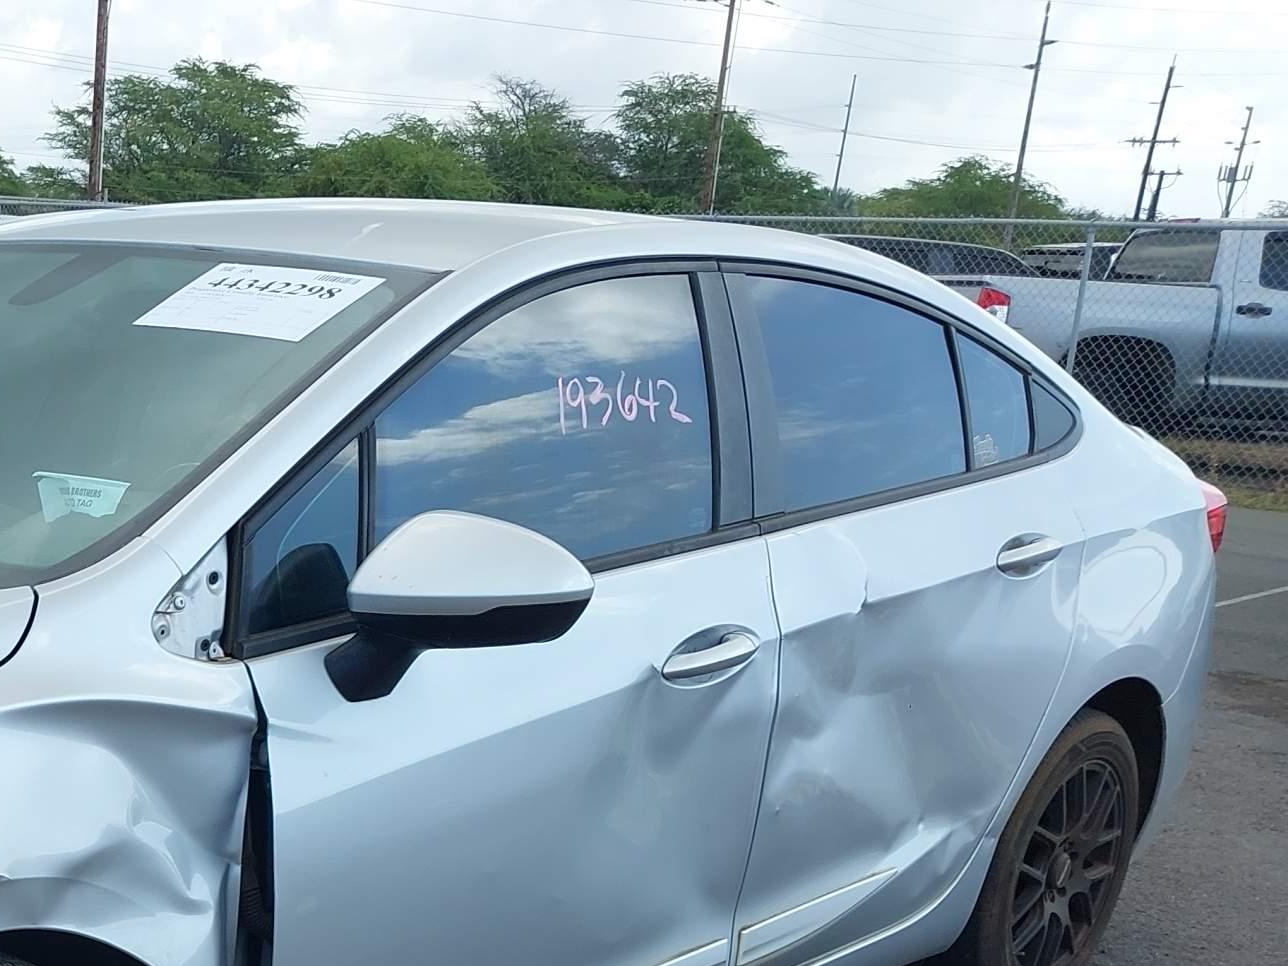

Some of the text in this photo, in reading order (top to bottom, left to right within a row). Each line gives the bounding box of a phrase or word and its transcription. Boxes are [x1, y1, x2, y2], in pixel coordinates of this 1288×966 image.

[208, 277, 343, 300] 44342298
[558, 370, 693, 435] 193642
[71, 486, 103, 498] BROTHERS
